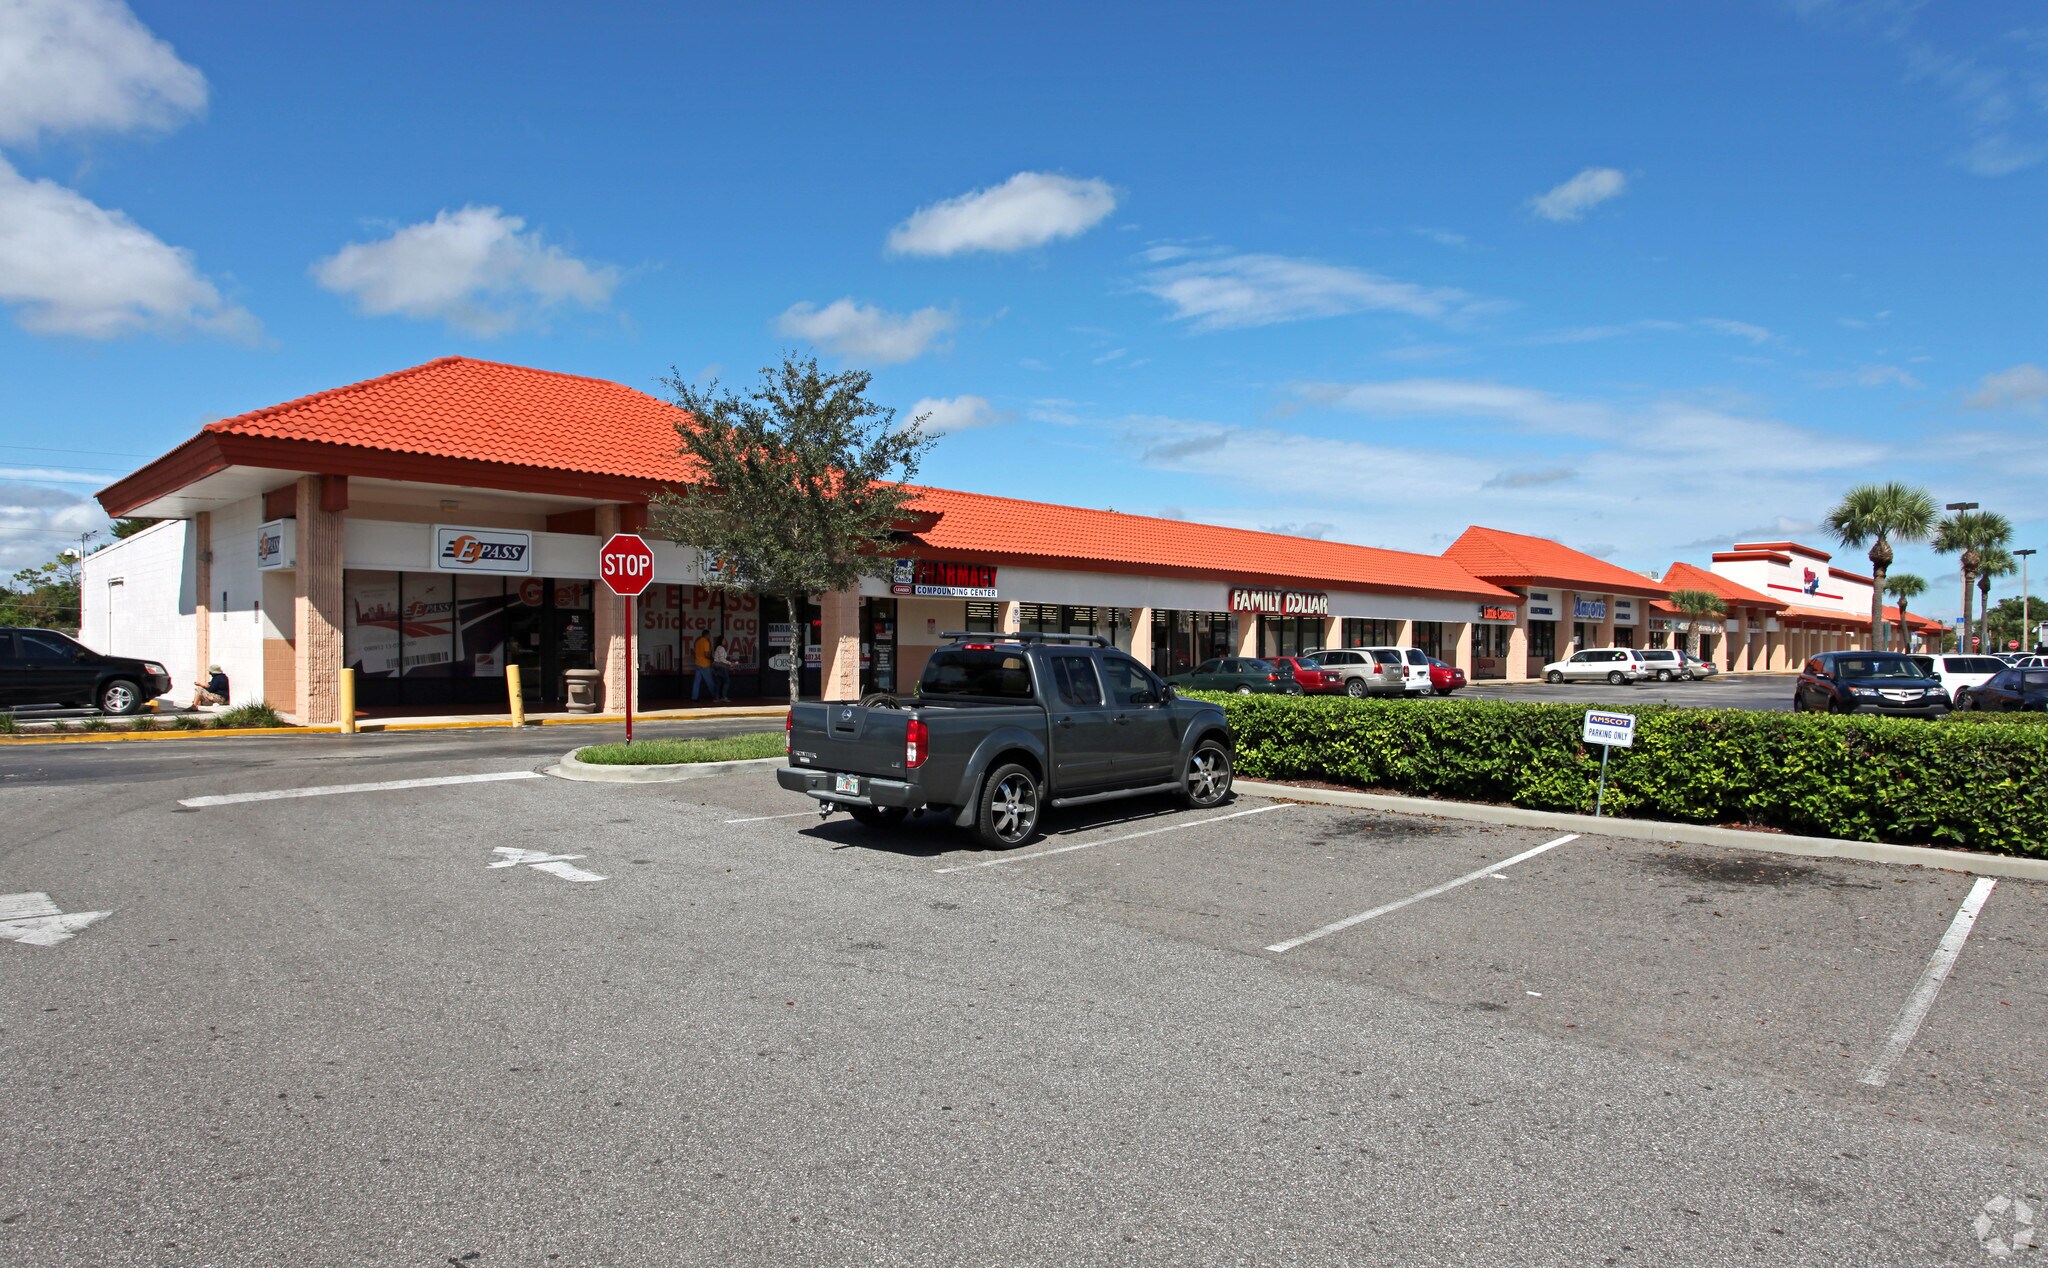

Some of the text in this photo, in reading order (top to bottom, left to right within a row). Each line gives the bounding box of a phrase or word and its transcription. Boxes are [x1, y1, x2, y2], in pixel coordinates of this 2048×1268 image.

[604, 553, 650, 576] STOP
[914, 562, 998, 587] PHARMACY
[520, 578, 581, 608] Get
[917, 586, 996, 597] COMPOUNDING CENTER
[1232, 589, 1329, 615] FAMILY DOLLAR
[644, 611, 757, 636] Sticker Tag
[683, 635, 757, 657] TAY
[1591, 715, 1629, 726] AMSCOT
[1588, 727, 1628, 741] PARKING ONLY
